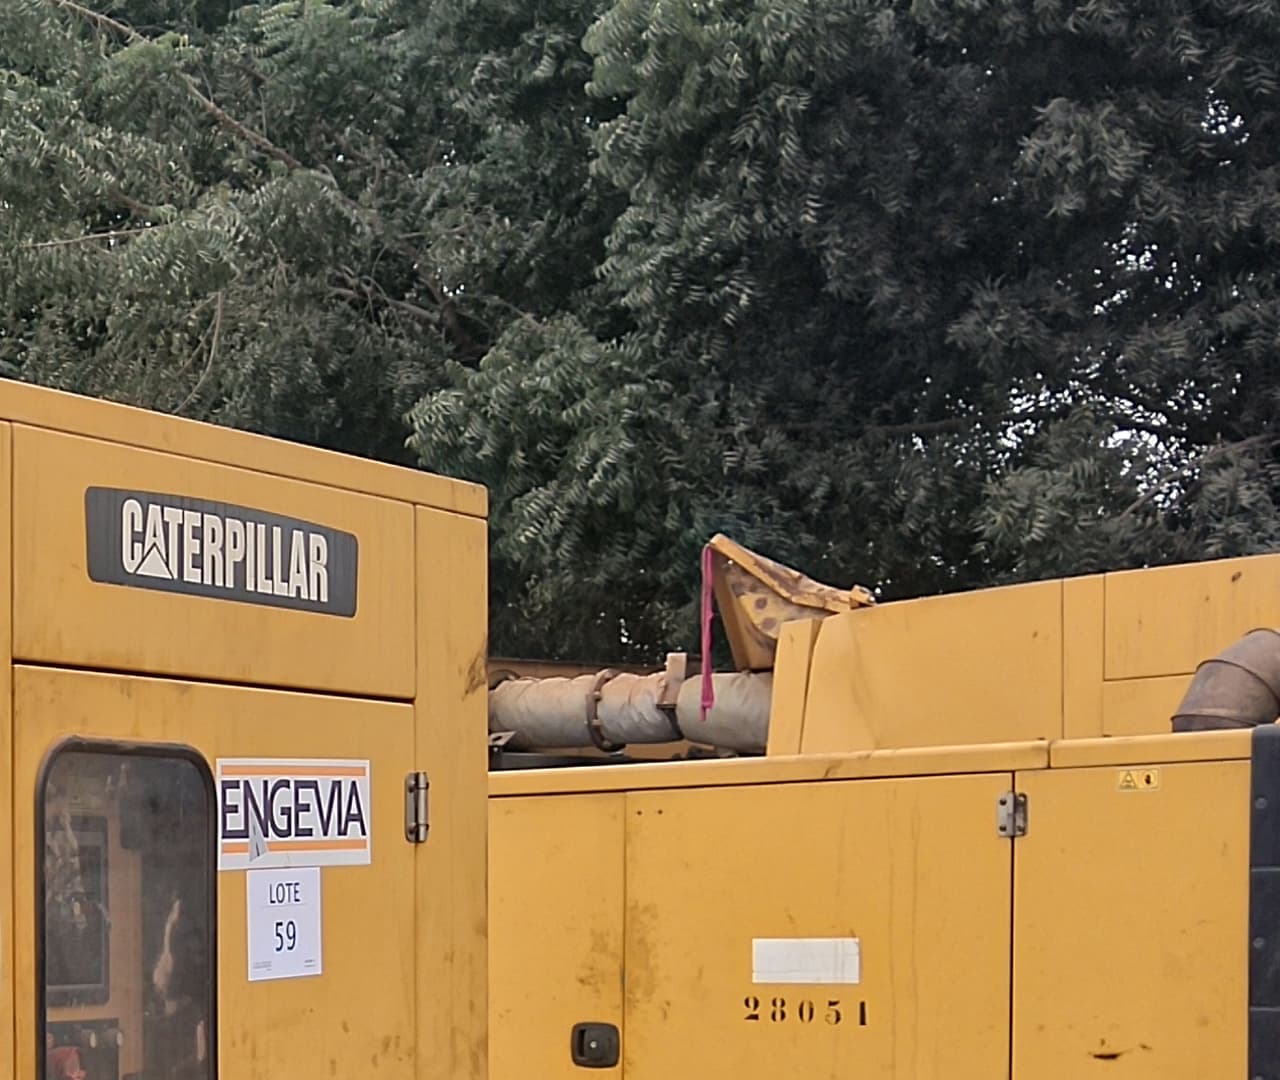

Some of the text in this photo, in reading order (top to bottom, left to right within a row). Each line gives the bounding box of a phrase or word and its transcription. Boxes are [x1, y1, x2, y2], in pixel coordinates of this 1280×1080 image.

[121, 498, 328, 603] CATERPILLAR
[221, 779, 367, 839] ENGEVIA
[269, 882, 301, 904] LOTE
[275, 921, 296, 952] 59
[744, 996, 867, 1026] 28051
